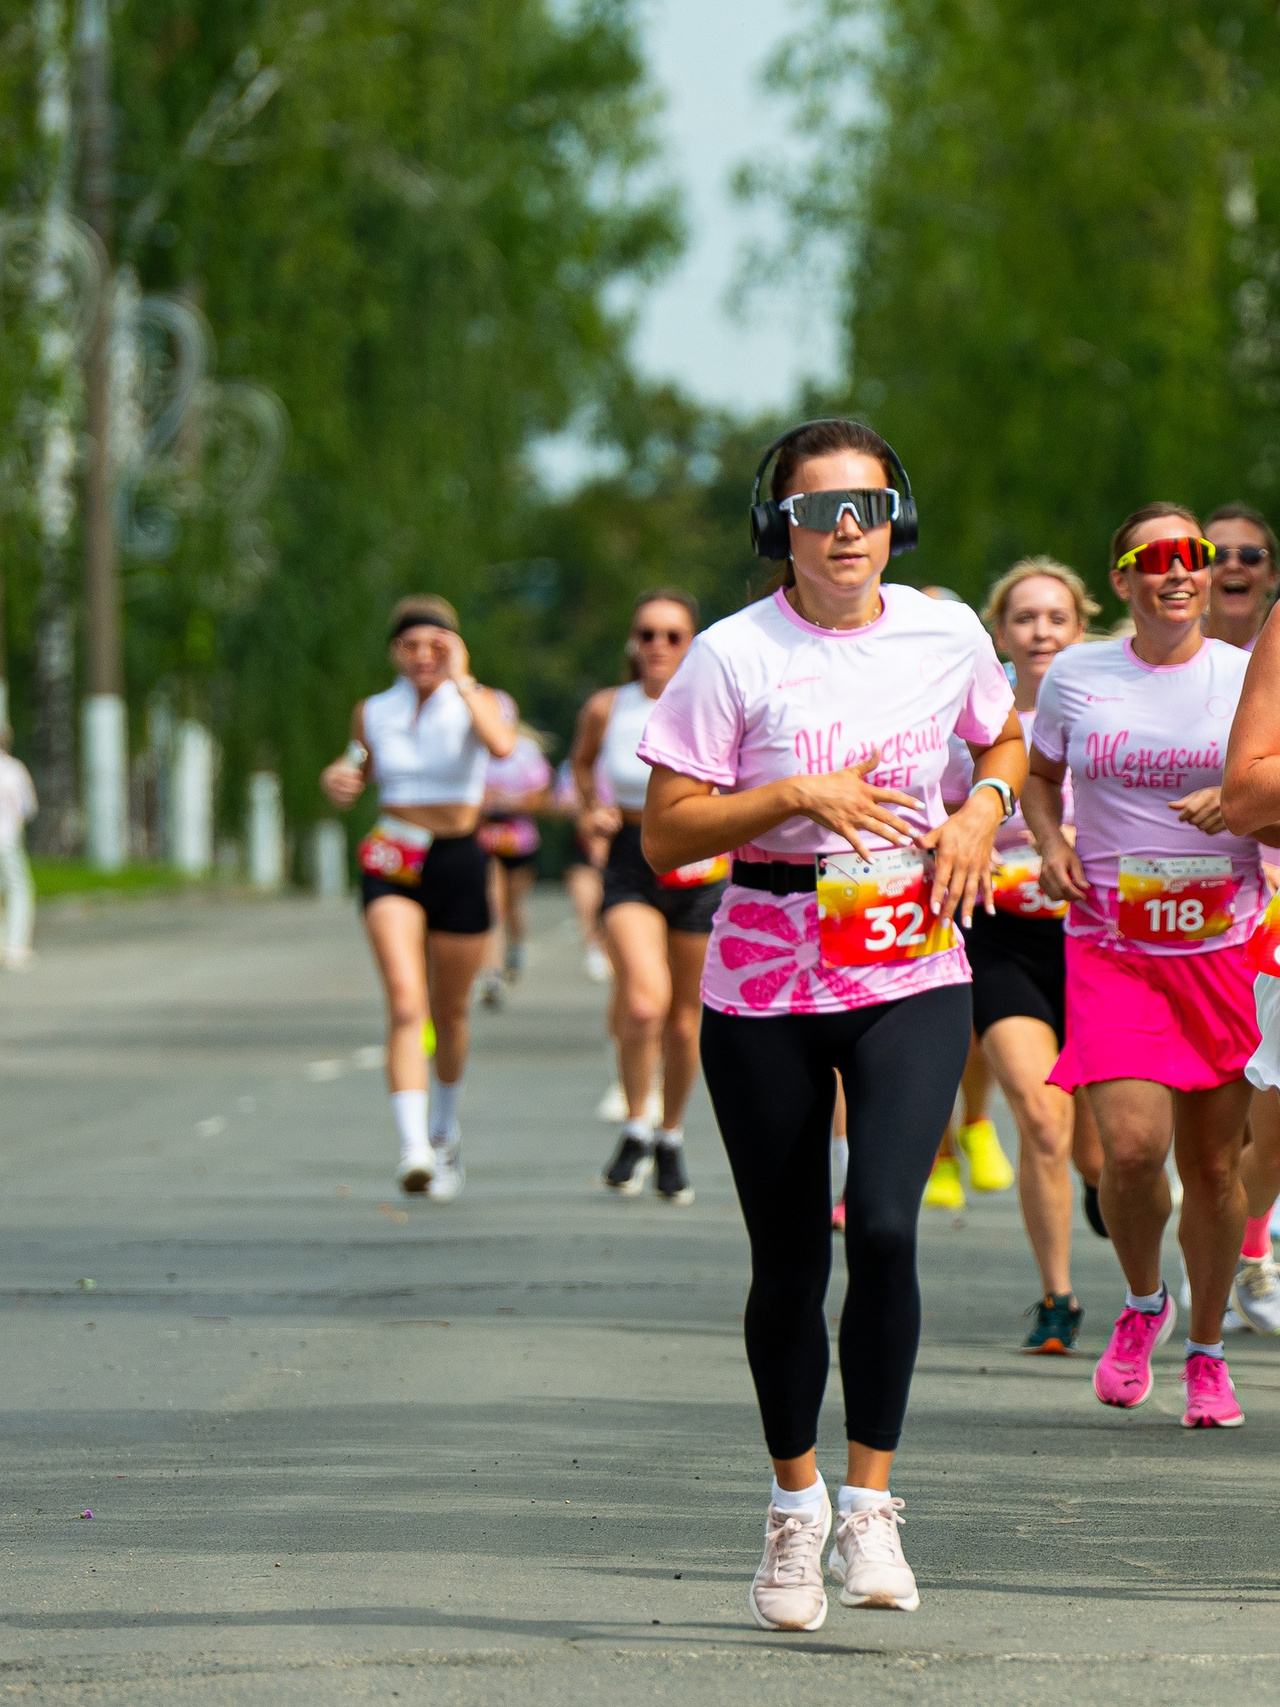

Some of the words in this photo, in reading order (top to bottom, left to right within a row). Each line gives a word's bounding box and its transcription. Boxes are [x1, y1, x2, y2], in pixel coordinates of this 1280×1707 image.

[1085, 730, 1224, 782] Женский
[862, 765, 919, 788] БЕГ
[1122, 773, 1189, 788] ЗАБЕГ
[865, 902, 926, 951] 32
[1144, 899, 1204, 932] 118
